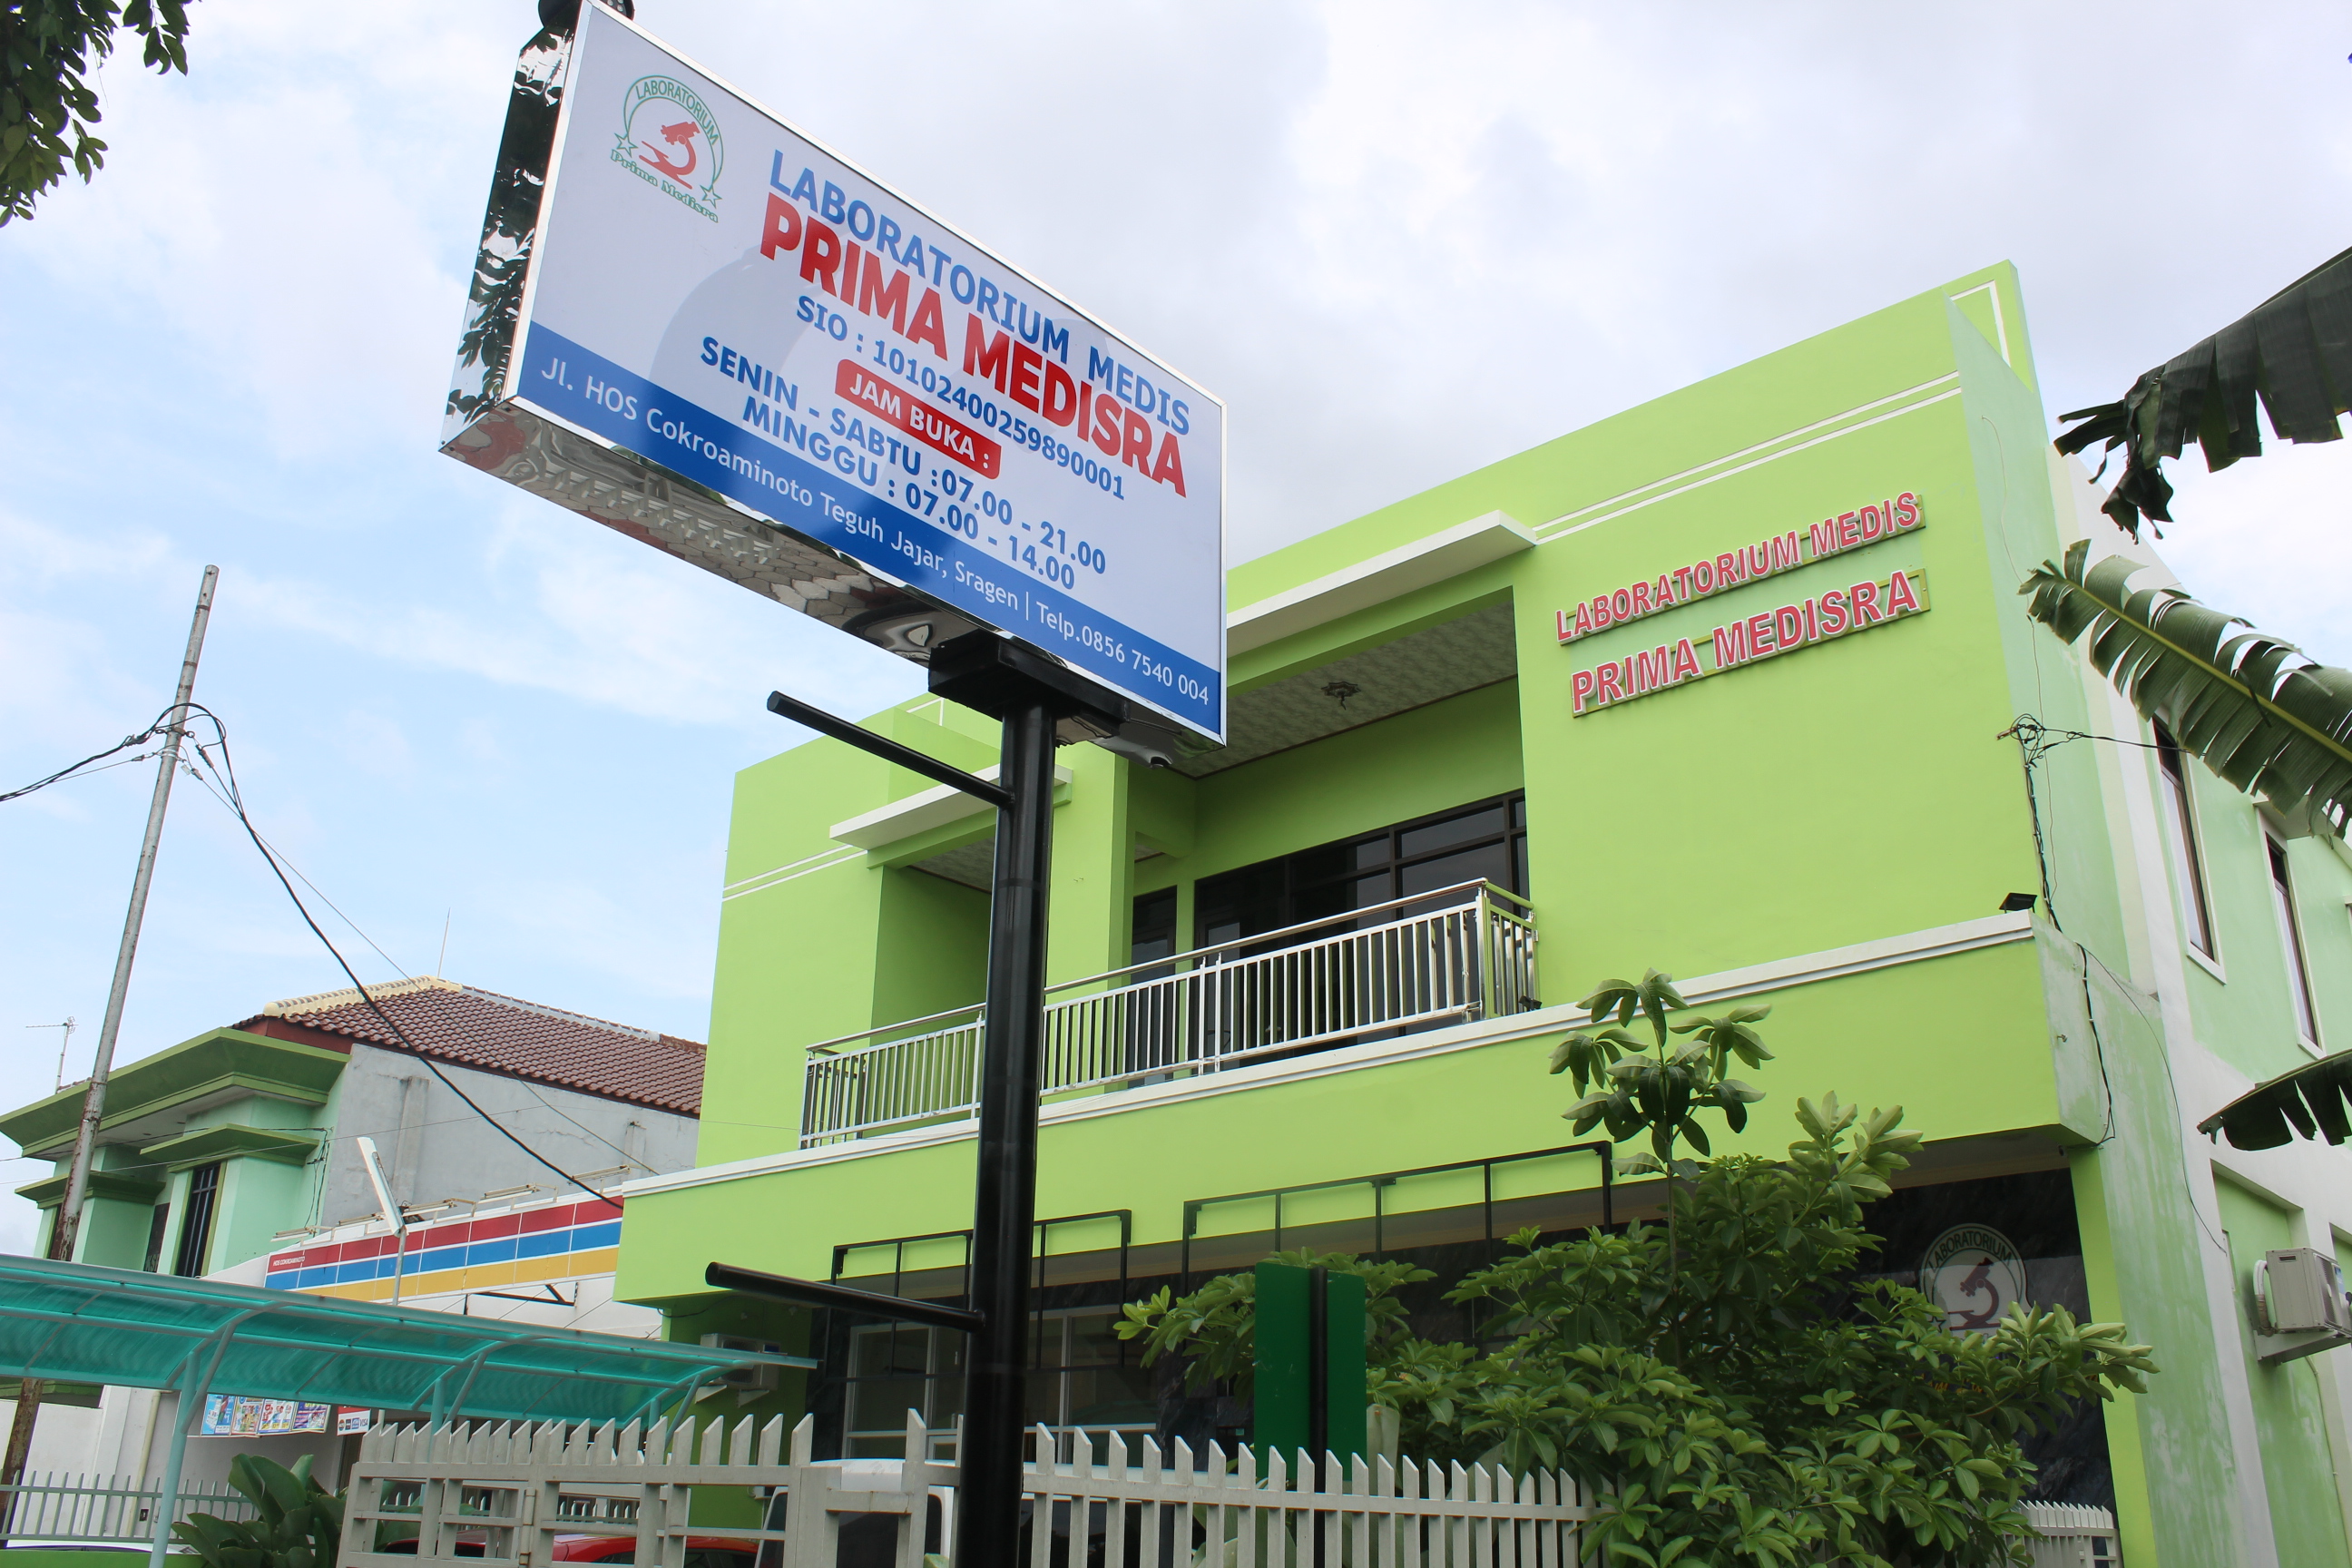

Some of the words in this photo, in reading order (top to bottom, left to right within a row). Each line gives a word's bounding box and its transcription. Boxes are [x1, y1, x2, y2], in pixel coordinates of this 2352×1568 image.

[610, 149, 659, 187] Prima
[661, 180, 719, 223] Medisra
[636, 80, 719, 145] LABORATORIUM
[760, 191, 948, 361] PRIMA
[963, 312, 1187, 498] MEDISRA
[770, 150, 1069, 363] LABORATORIUM
[1088, 346, 1191, 435] MEDIS
[701, 336, 799, 411] SENIN
[829, 408, 921, 475] SABTU
[1040, 520, 1106, 574] 21.00
[796, 295, 848, 342] SIO
[873, 339, 1125, 500] 10102400259890001
[849, 373, 902, 420] JAM
[909, 405, 975, 462] BUKA
[541, 357, 573, 391] Jl.
[585, 375, 638, 420] HOS
[646, 407, 813, 507] Cokroaminoto
[819, 492, 884, 544] Teguh
[890, 531, 948, 579] Jajar,
[955, 561, 1019, 612] Sragen
[1132, 649, 1172, 687] 7540
[1178, 674, 1210, 706] 004
[742, 396, 878, 487] MINGGU
[905, 482, 979, 540] 07.00
[1008, 535, 1075, 591] 14.00
[1555, 530, 1801, 642] LABORATORIUM
[1808, 491, 1922, 559] MEDIS
[1571, 636, 1704, 715] PRIMA
[1712, 569, 1924, 670] MEDISRA
[1928, 1230, 2012, 1273] LABORATORIUM
